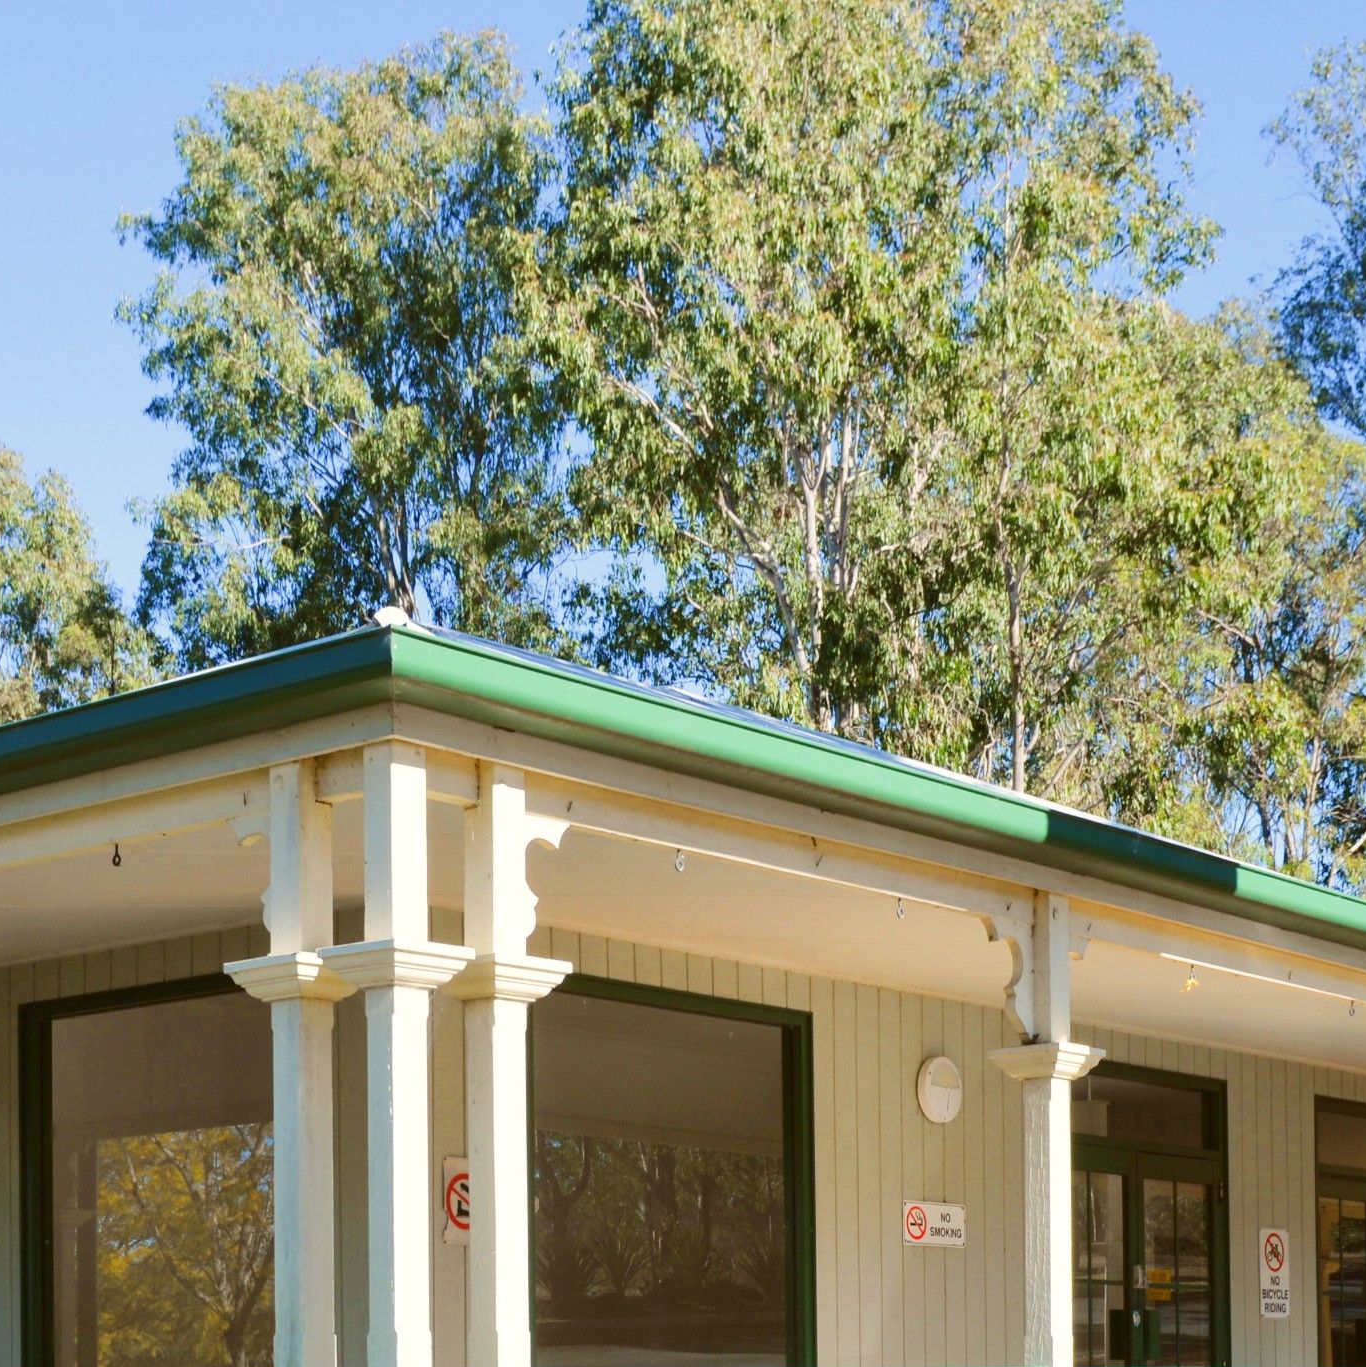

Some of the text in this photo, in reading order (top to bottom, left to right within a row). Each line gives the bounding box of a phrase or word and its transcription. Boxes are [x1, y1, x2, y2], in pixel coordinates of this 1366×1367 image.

[940, 1213, 951, 1223] NO
[930, 1227, 962, 1238] SMOKING
[1270, 1276, 1280, 1286] NO
[1262, 1289, 1288, 1299] BICYCLE
[1264, 1303, 1286, 1313] RIDING
